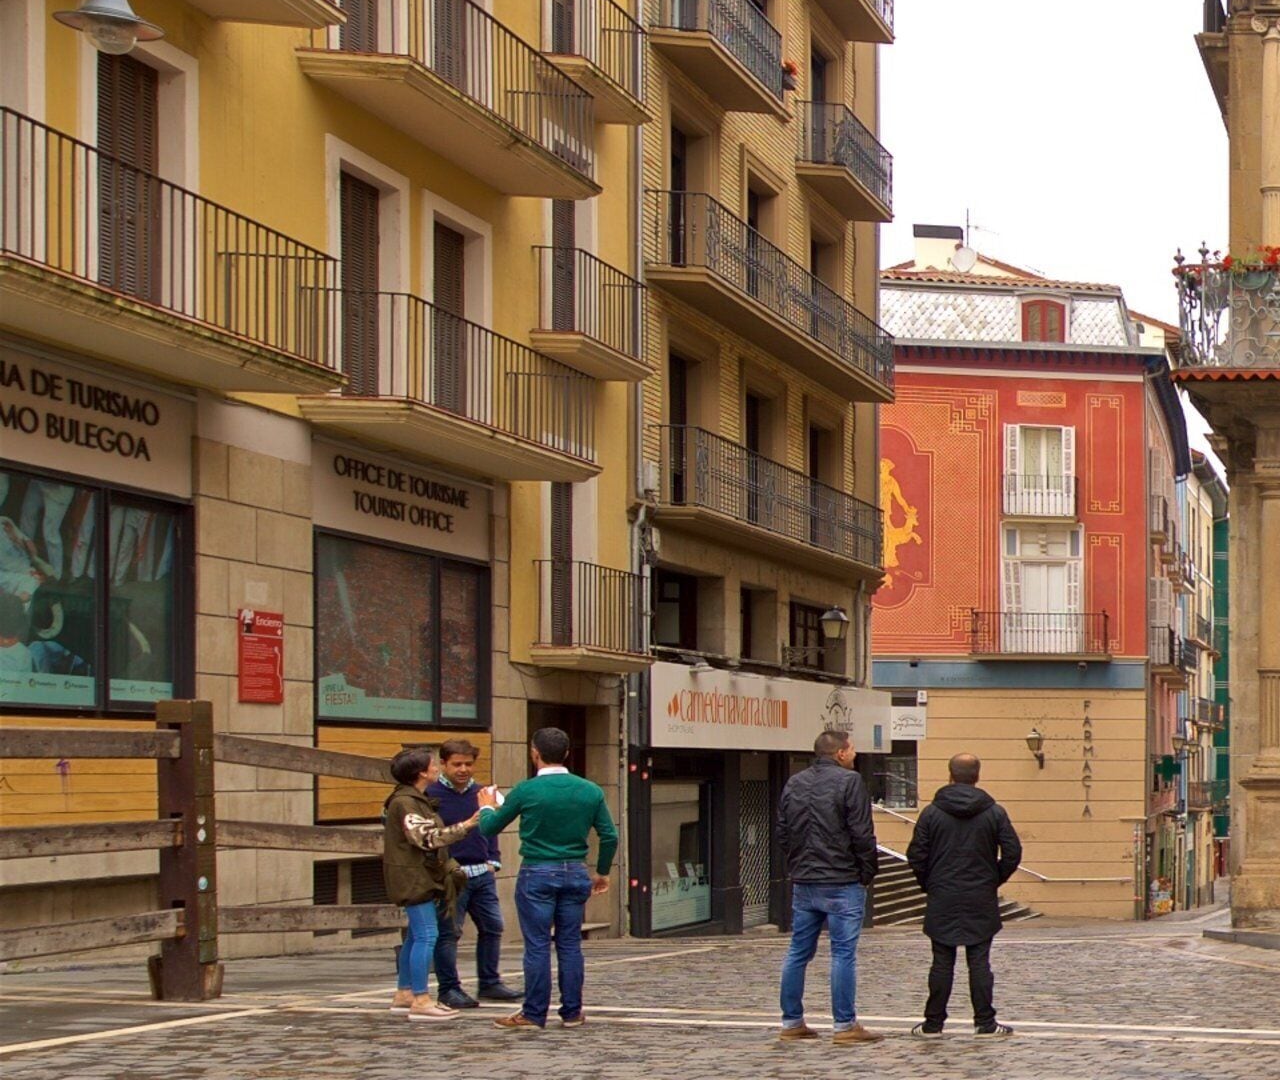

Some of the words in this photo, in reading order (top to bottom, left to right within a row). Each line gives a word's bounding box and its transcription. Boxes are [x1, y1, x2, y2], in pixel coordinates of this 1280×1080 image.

[31, 369, 63, 401] DE
[66, 379, 160, 426] TURISMO
[46, 413, 151, 462] BULEGOA
[333, 455, 385, 486] OFFICE
[387, 470, 406, 493] DE
[408, 475, 470, 509] TOURISME
[353, 490, 406, 521] TOURIST
[408, 505, 454, 533] OFFICE
[1082, 700, 1094, 818] FARMACIA
